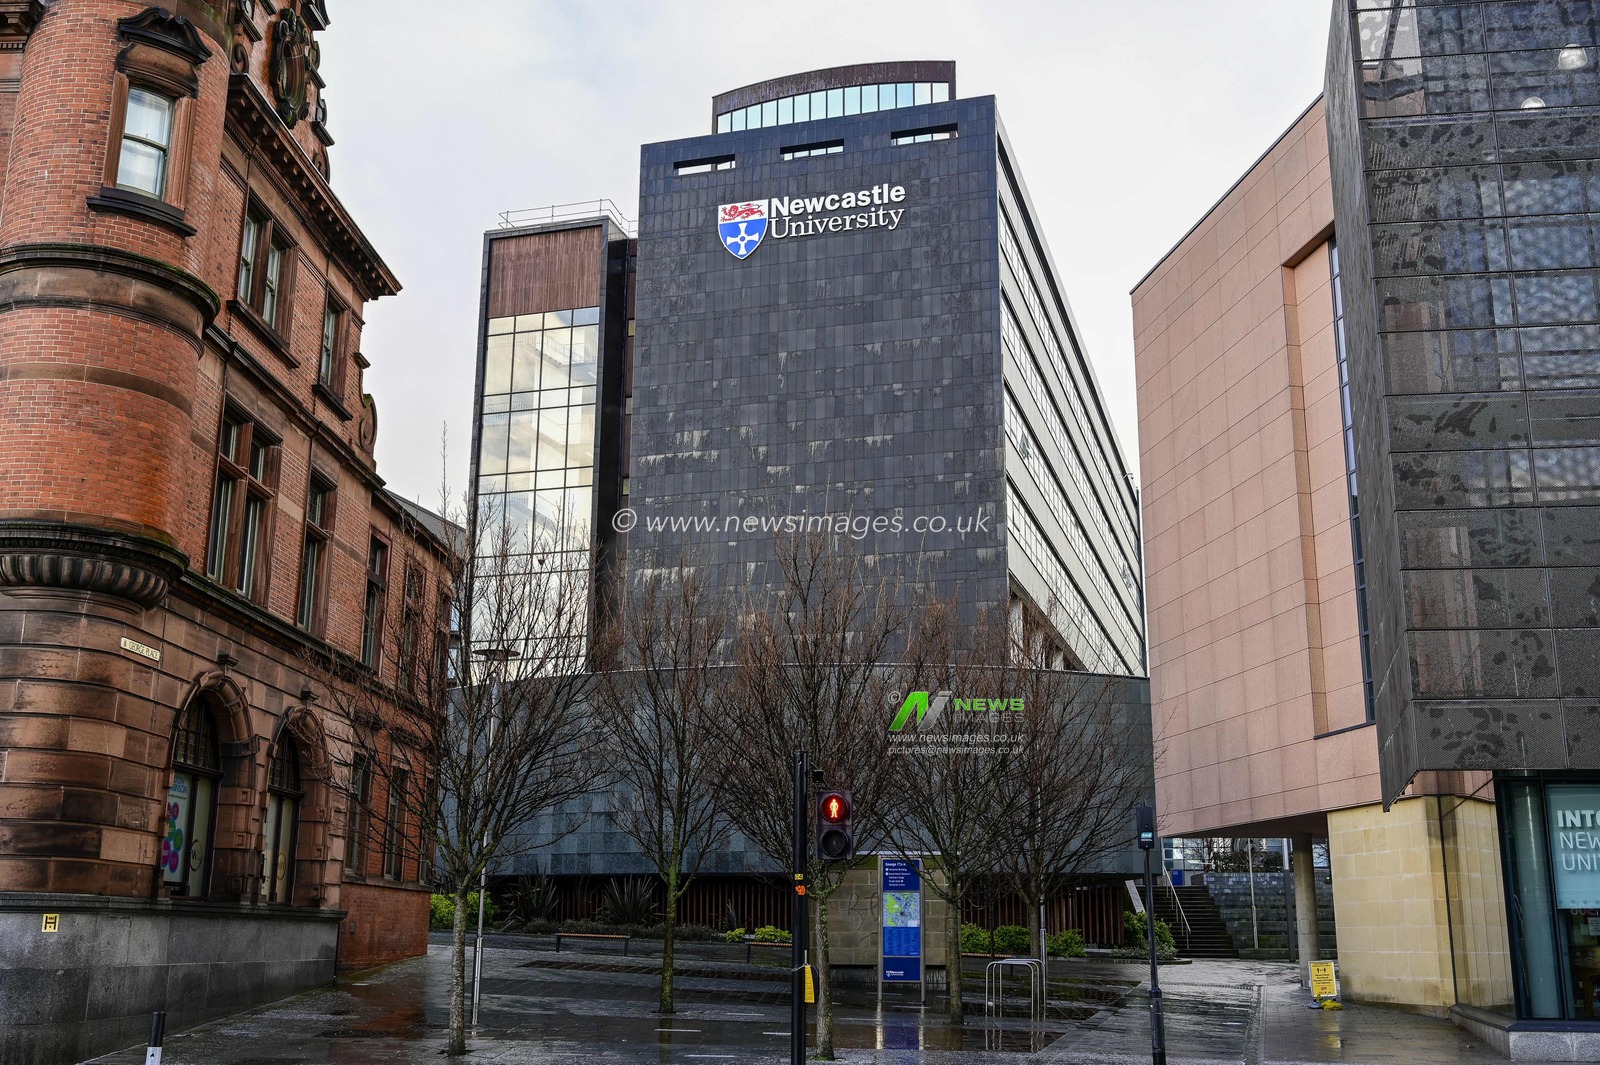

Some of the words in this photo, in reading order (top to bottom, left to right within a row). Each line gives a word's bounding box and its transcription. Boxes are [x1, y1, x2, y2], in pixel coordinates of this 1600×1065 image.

[771, 183, 906, 218] Newcastle
[769, 206, 905, 239] University
[145, 647, 158, 660] PLACE
[1562, 853, 1600, 871] UNI
